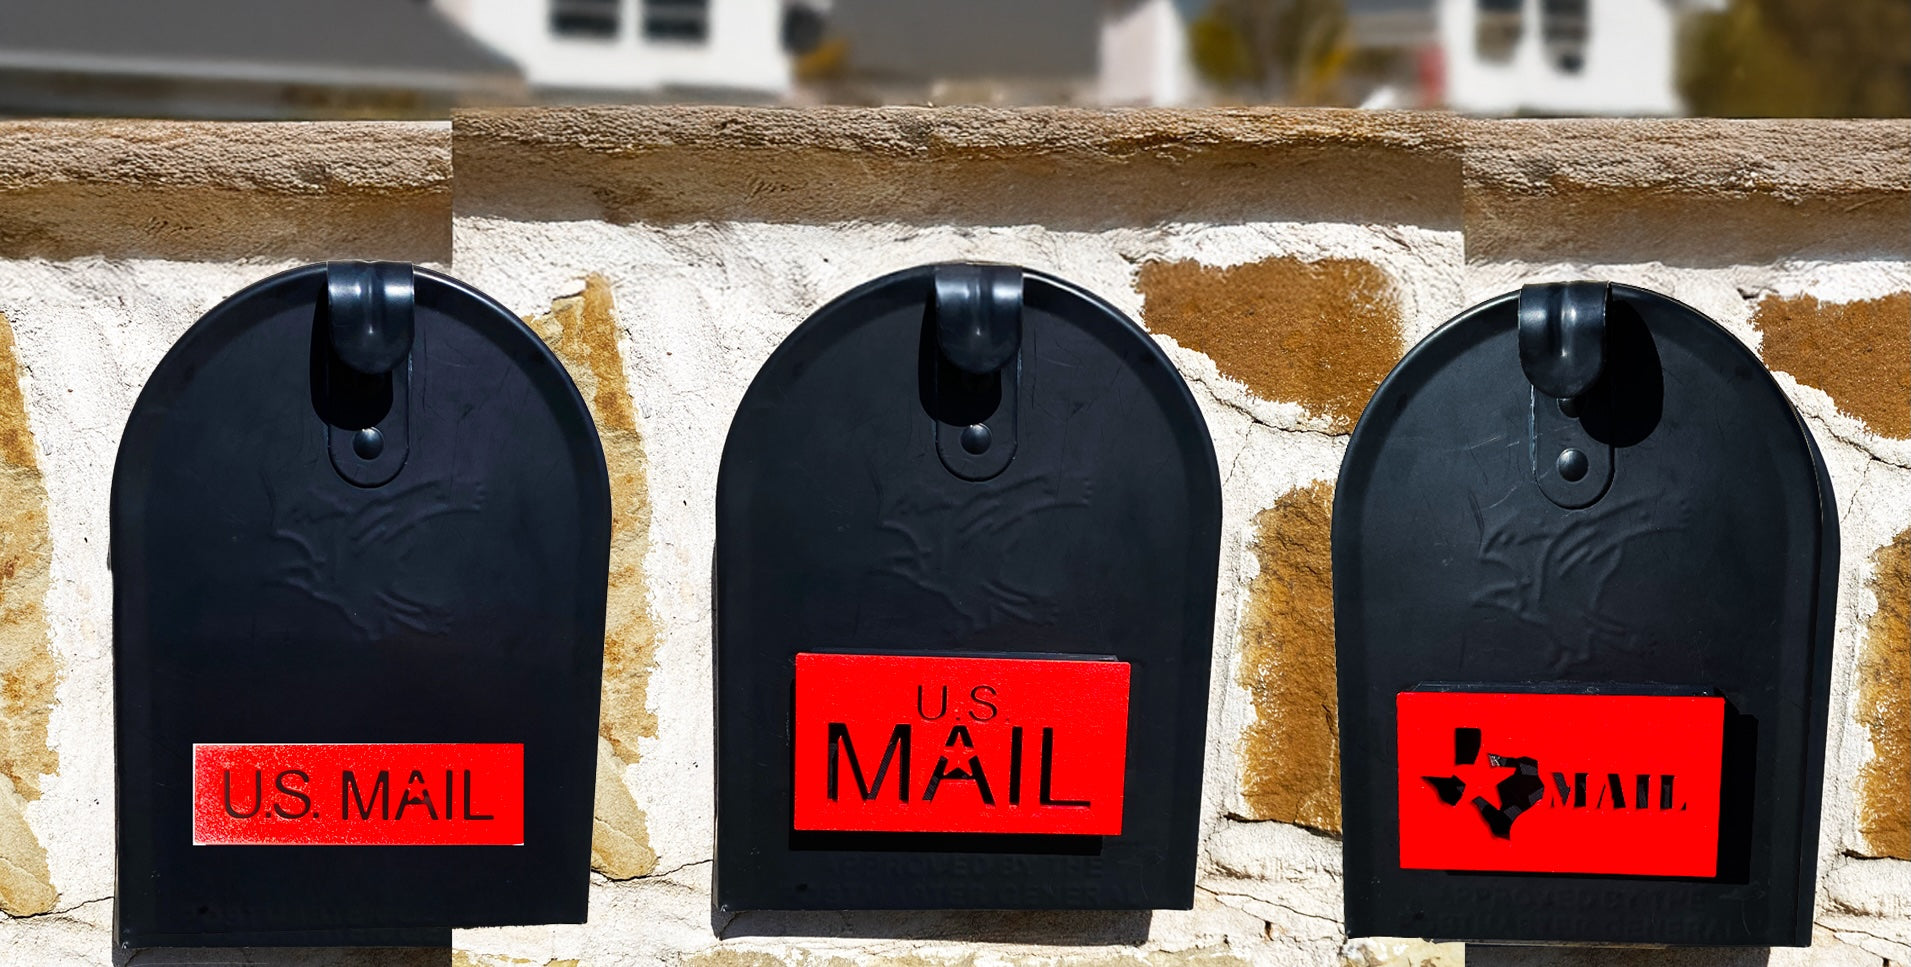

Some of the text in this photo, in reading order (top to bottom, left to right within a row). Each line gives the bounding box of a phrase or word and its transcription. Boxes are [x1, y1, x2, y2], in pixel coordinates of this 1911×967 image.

[827, 723, 1092, 806] MAIL
[223, 769, 495, 821] U.S. MAIL
[1550, 772, 1687, 812] MAIL
